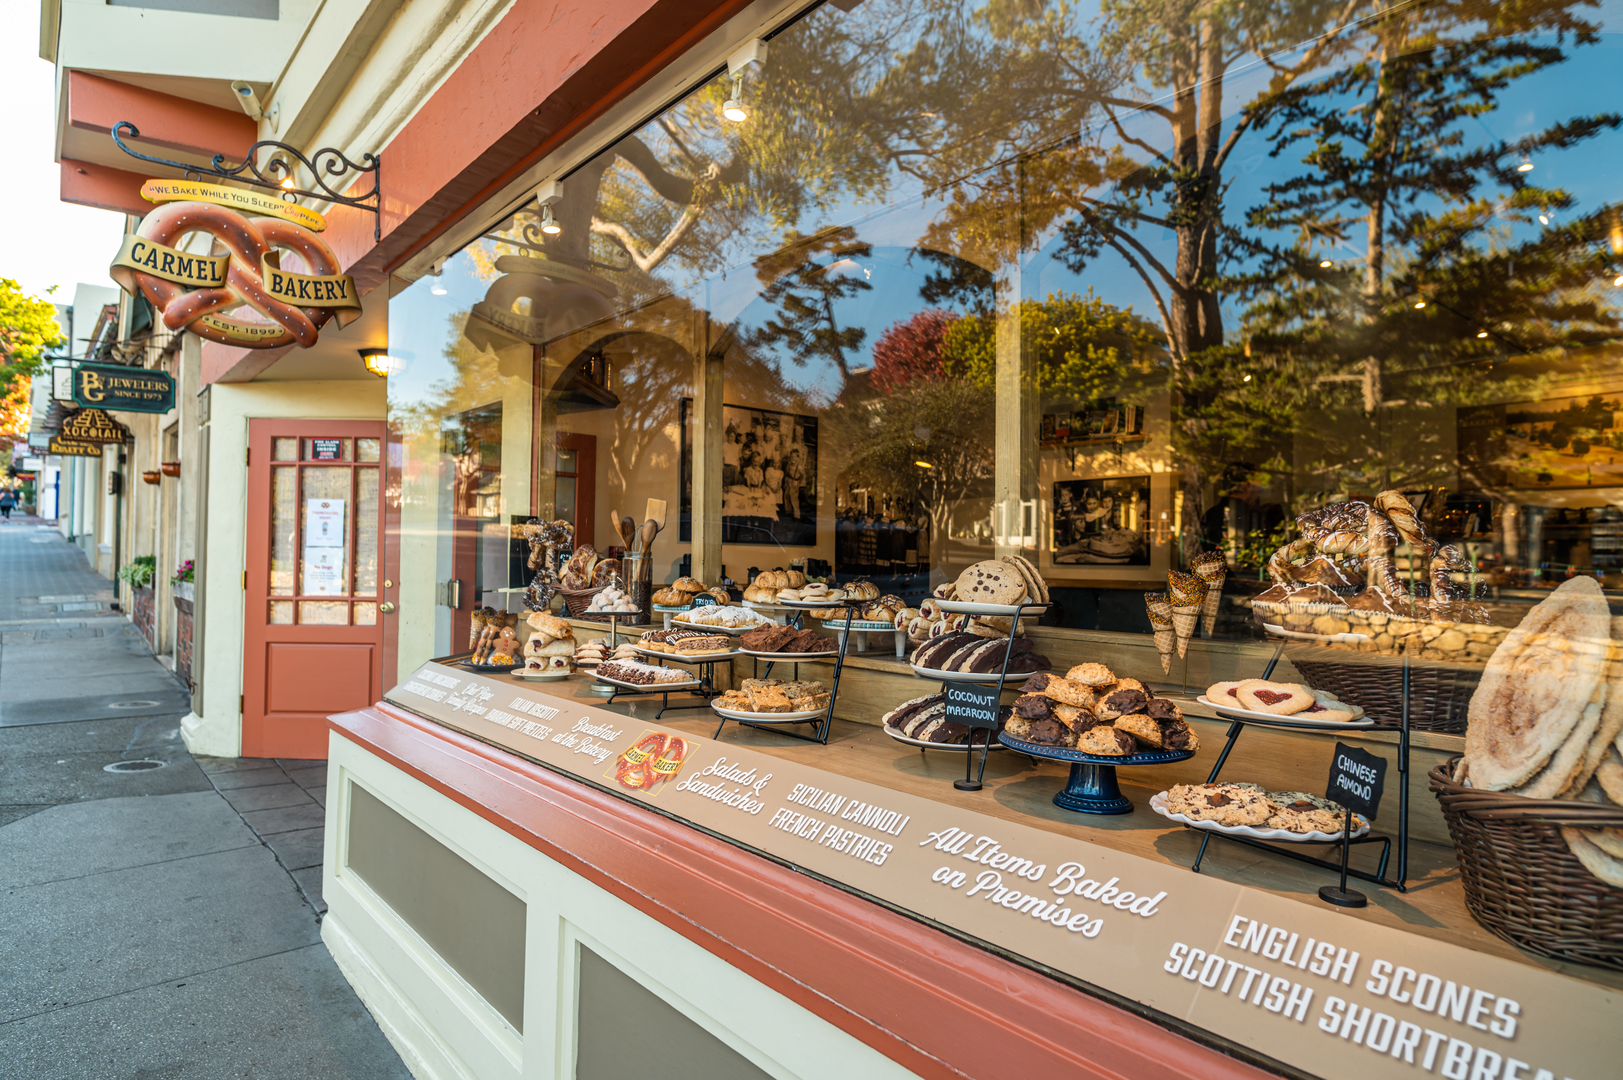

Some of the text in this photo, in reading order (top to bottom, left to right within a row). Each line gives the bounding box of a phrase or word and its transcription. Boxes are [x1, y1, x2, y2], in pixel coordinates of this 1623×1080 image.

[172, 186, 198, 196] BAKE
[200, 188, 229, 200] WHILE
[230, 194, 248, 204] YOU
[131, 242, 348, 300] CARMEL BAKERY
[212, 320, 276, 336] EST. 1899
[108, 377, 170, 392] JEWELERS
[114, 390, 141, 398] SINCE
[947, 705, 995, 721] MACAROON
[948, 689, 995, 706] COCONUT
[507, 716, 528, 732] SOFT
[520, 721, 553, 741] PRETZELS
[572, 716, 623, 741] Breakfast
[551, 732, 613, 764] at the Bakery
[654, 760, 681, 771] BAKERY
[702, 757, 772, 796] Salads &
[1338, 754, 1377, 784] CHINESE
[676, 772, 765, 814] Sandwiches
[787, 784, 910, 836] SICILIAN CANNOLI
[768, 808, 894, 866] FRENCH PASTRIES
[920, 827, 1168, 917] All Items Baked
[932, 866, 1104, 938] on Premises
[1164, 942, 1314, 1022] SCOTTISH
[1224, 914, 1520, 1039] ENGLISH SCONES
